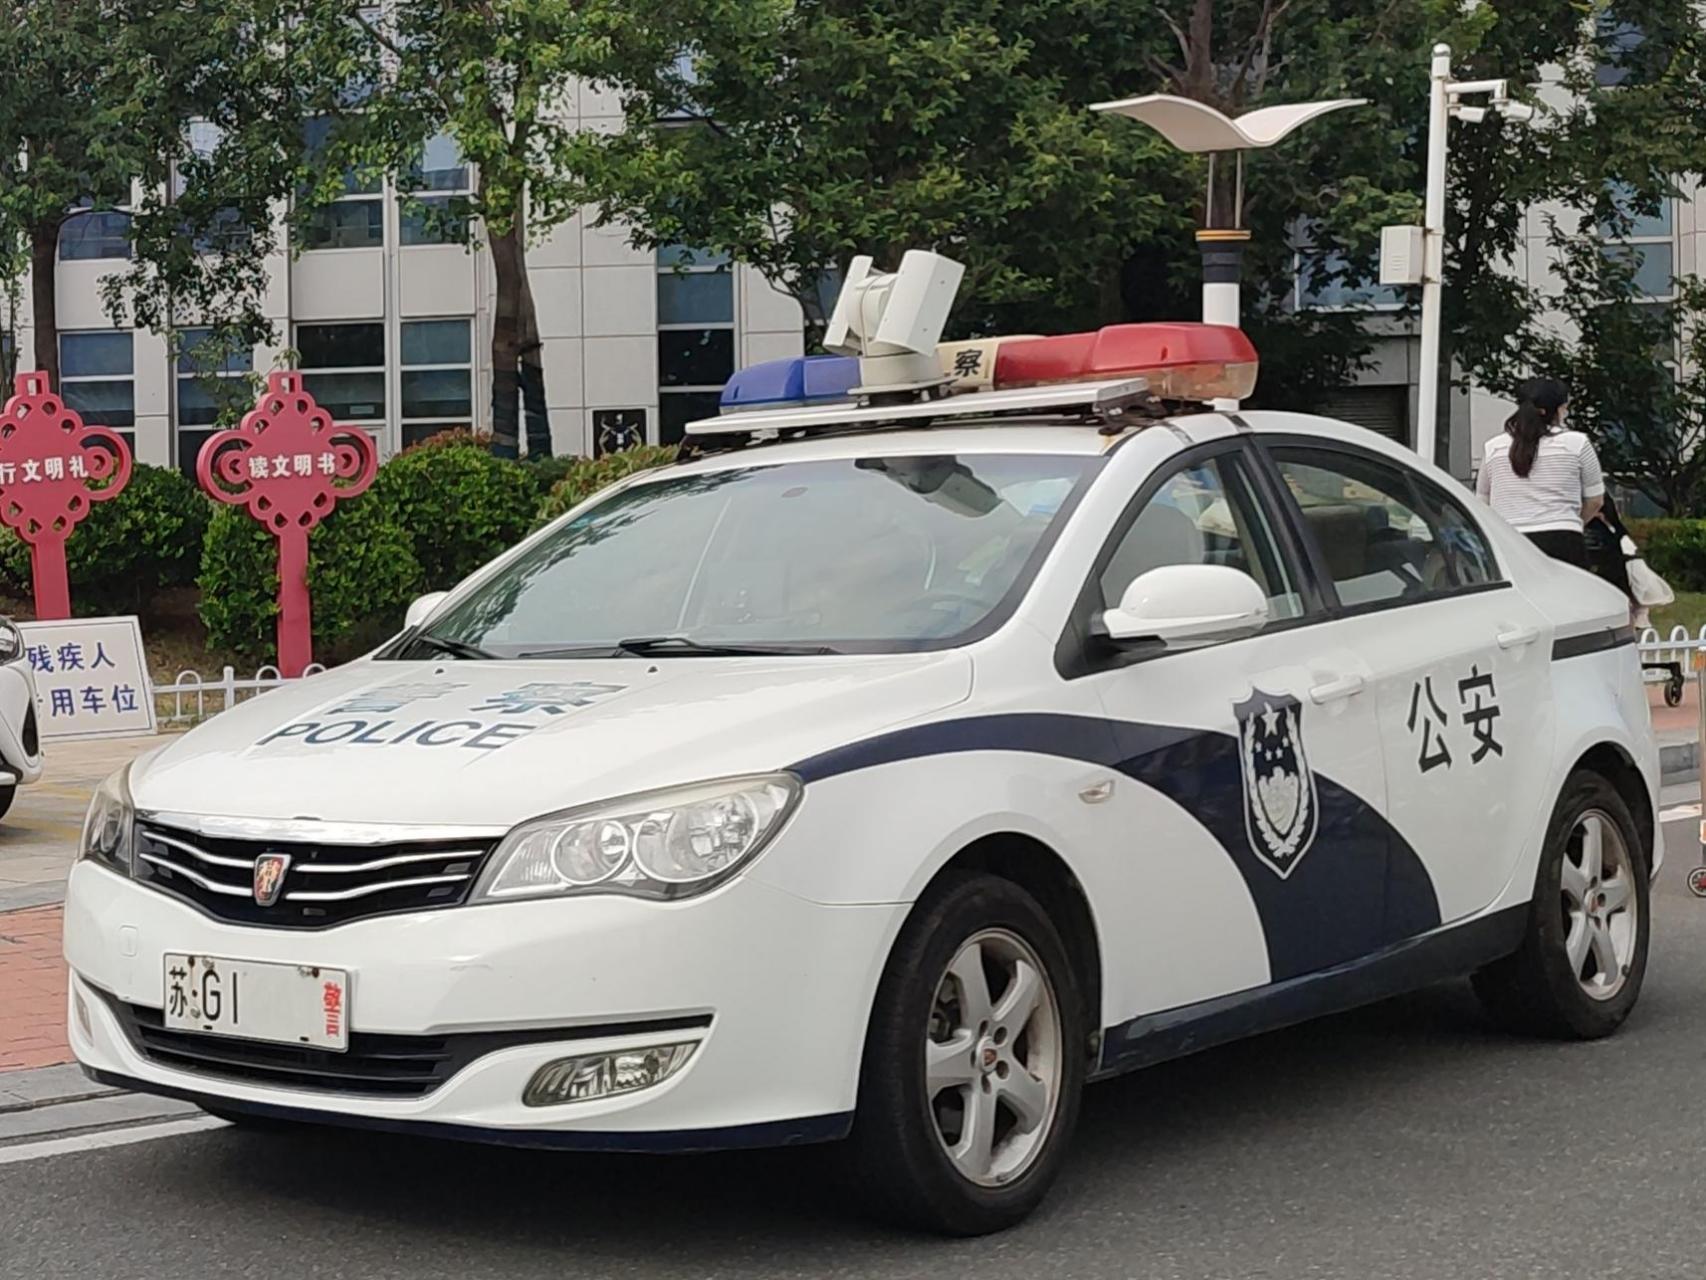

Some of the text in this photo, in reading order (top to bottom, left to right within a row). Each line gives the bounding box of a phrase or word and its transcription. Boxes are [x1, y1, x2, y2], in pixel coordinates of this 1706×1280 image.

[954, 348, 983, 378] 察
[0, 455, 90, 485] 行文明礼
[248, 452, 336, 479] 读文明书
[26, 642, 116, 673] 残疾人
[36, 684, 139, 717] 用车位
[1406, 663, 1504, 774] 公安
[255, 719, 538, 750] POLICE
